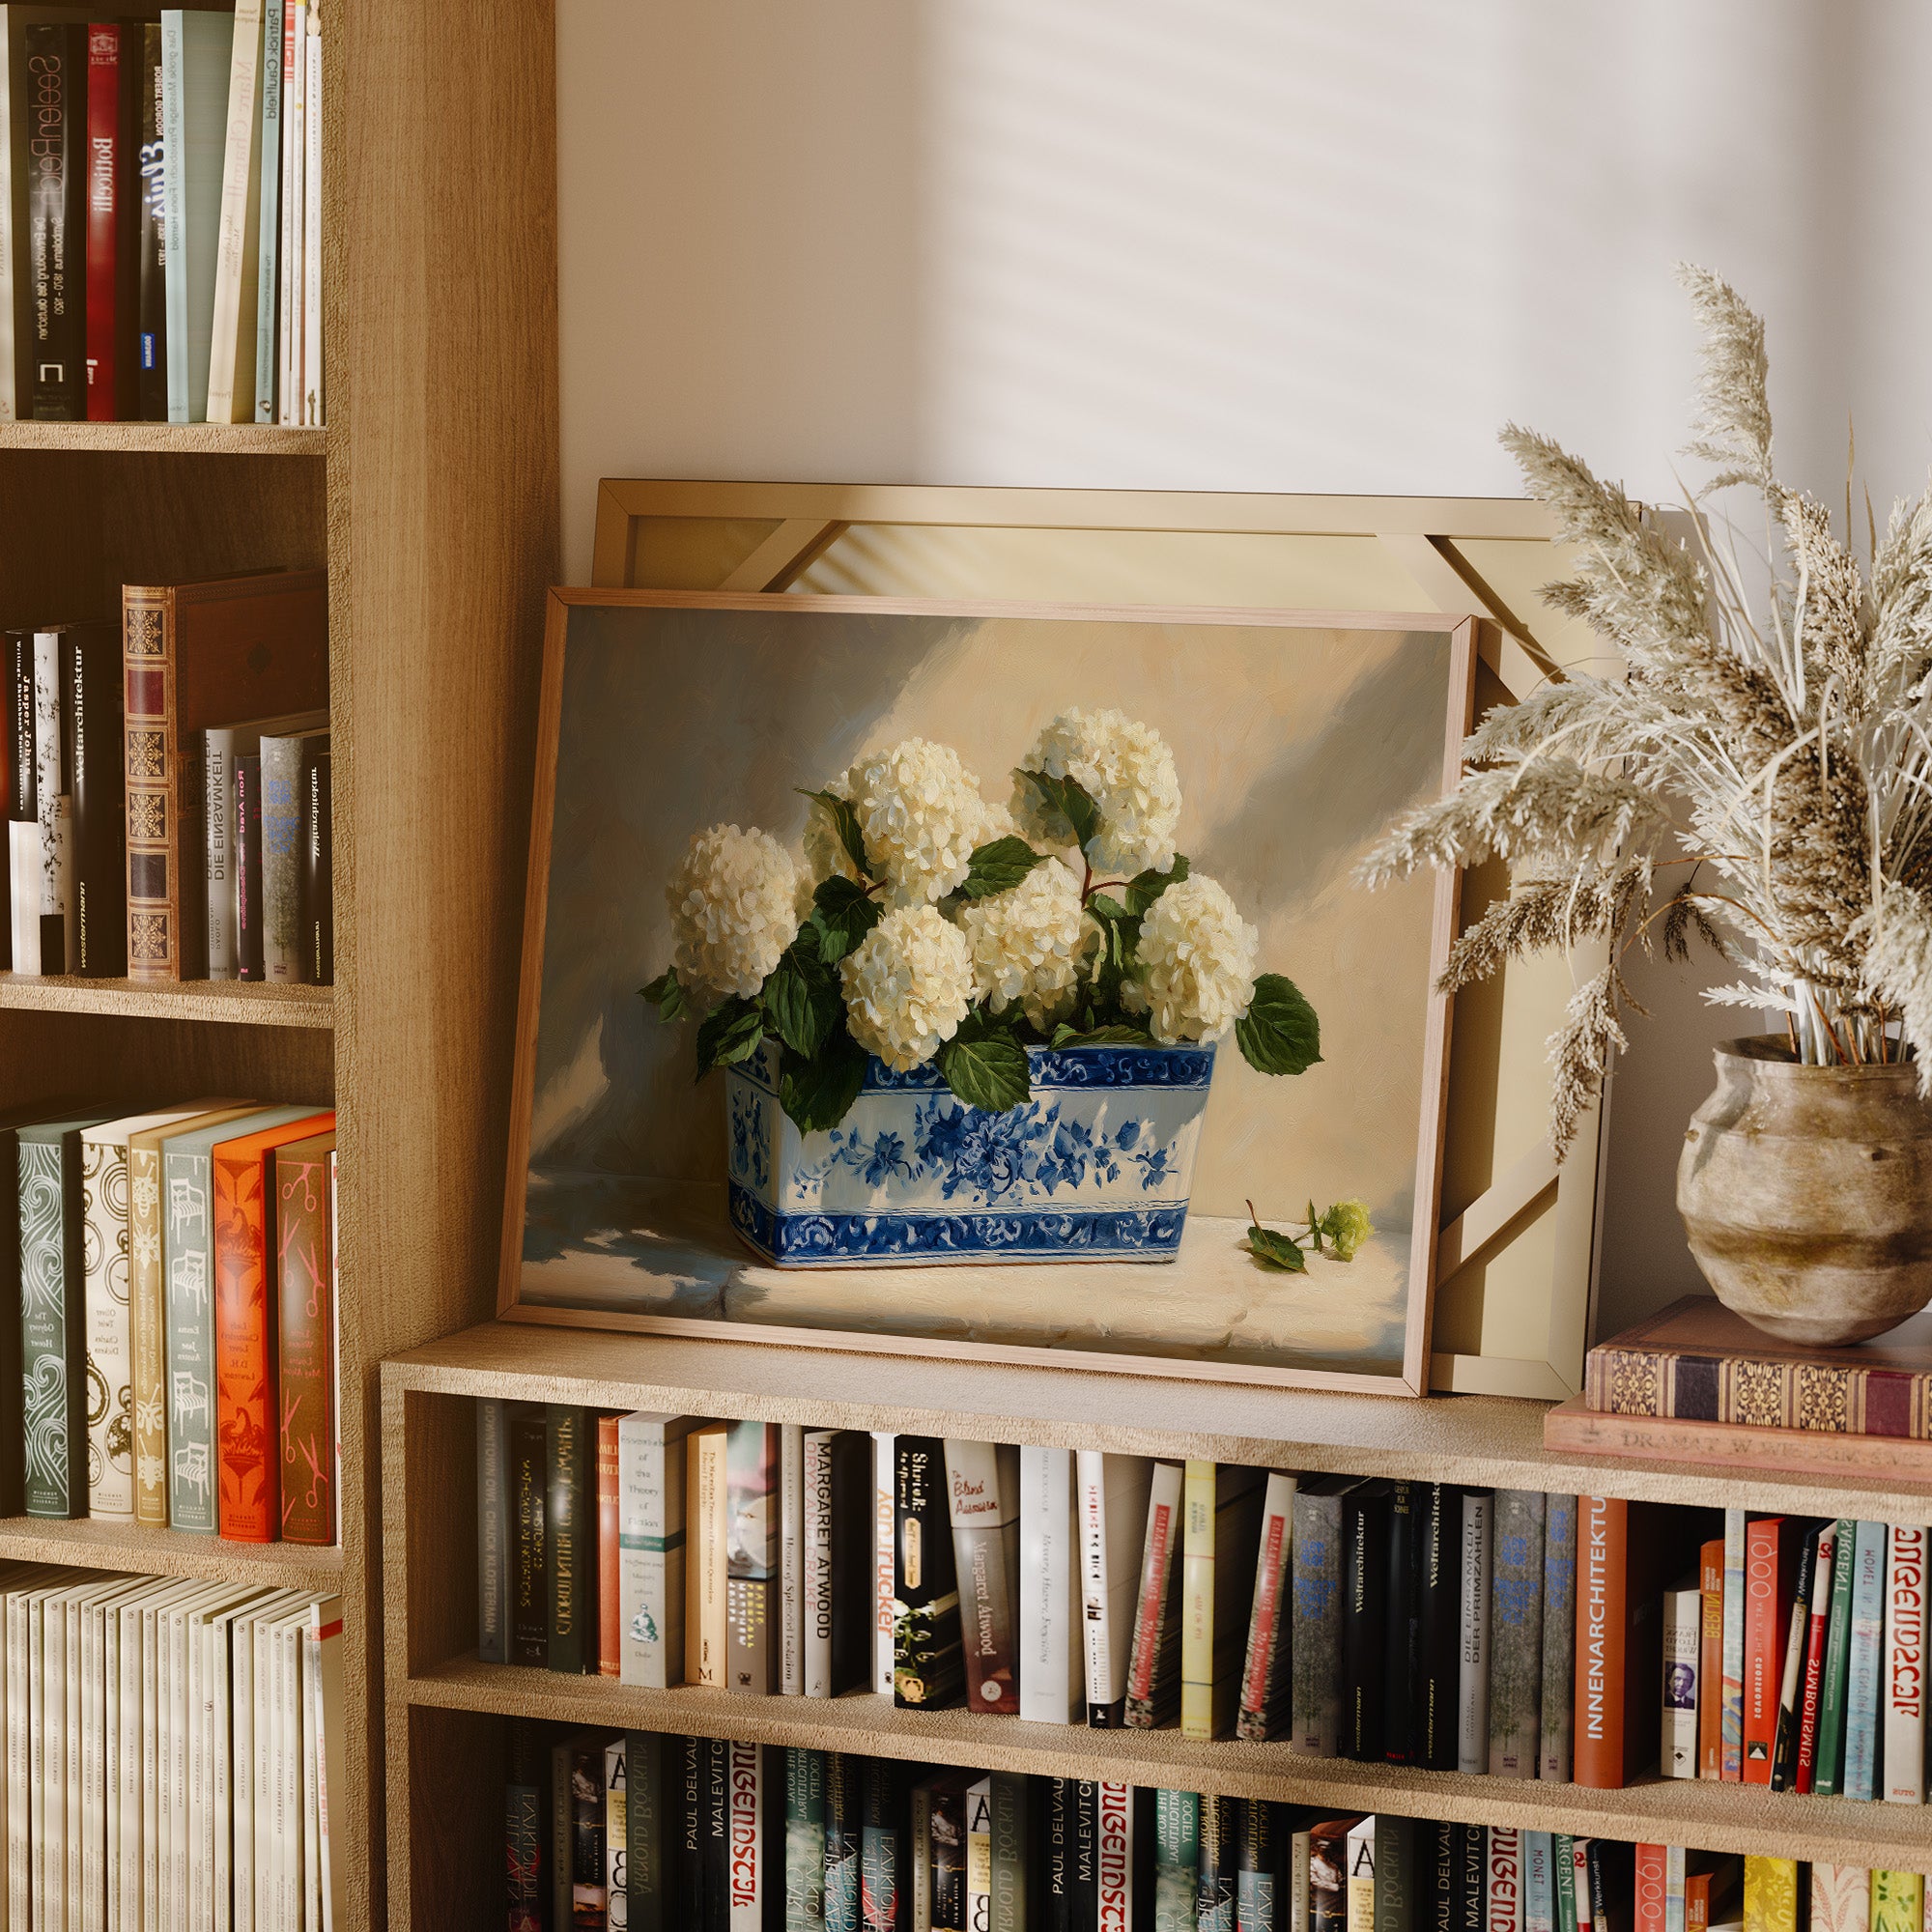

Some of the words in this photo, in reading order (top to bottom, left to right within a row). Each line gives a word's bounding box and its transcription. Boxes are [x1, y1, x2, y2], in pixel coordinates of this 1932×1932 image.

[22, 675, 31, 727] Jasper
[74, 645, 85, 784] Weltarchitektur
[485, 1406, 497, 1477] DOWNTOWN
[1620, 1430, 1721, 1453] DRAMAT
[1731, 1438, 1752, 1455] W
[629, 1485, 659, 1496] Theory
[805, 1441, 817, 1492] ORYX
[953, 1480, 984, 1497] Blind
[485, 1479, 497, 1505] OWL
[817, 1442, 831, 1551] MARGARET
[955, 1499, 999, 1515] Assassin
[485, 1510, 497, 1551] CHUCK
[628, 1517, 659, 1527] Fiction
[805, 1500, 817, 1540] AND
[805, 1546, 817, 1612] CRAKE
[973, 1541, 988, 1601] Margaret
[1355, 1511, 1366, 1614] Weltarchitektur
[1465, 1522, 1474, 1636] EINSAMKEIT
[1473, 1505, 1483, 1622] PRIMZAHLEN
[485, 1555, 497, 1634] KLOSTERMAN
[816, 1556, 831, 1639] ATWOOD
[977, 1602, 997, 1657] Atwood
[1464, 1640, 1473, 1662] DIE
[1471, 1627, 1481, 1663] DER
[687, 1808, 699, 1851] PAUL
[1051, 1850, 1065, 1895] PAUL
[1533, 1849, 1544, 1886] MONET
[1593, 1860, 1604, 1908] Werkkunst
[1635, 1855, 1663, 1919] 1900
